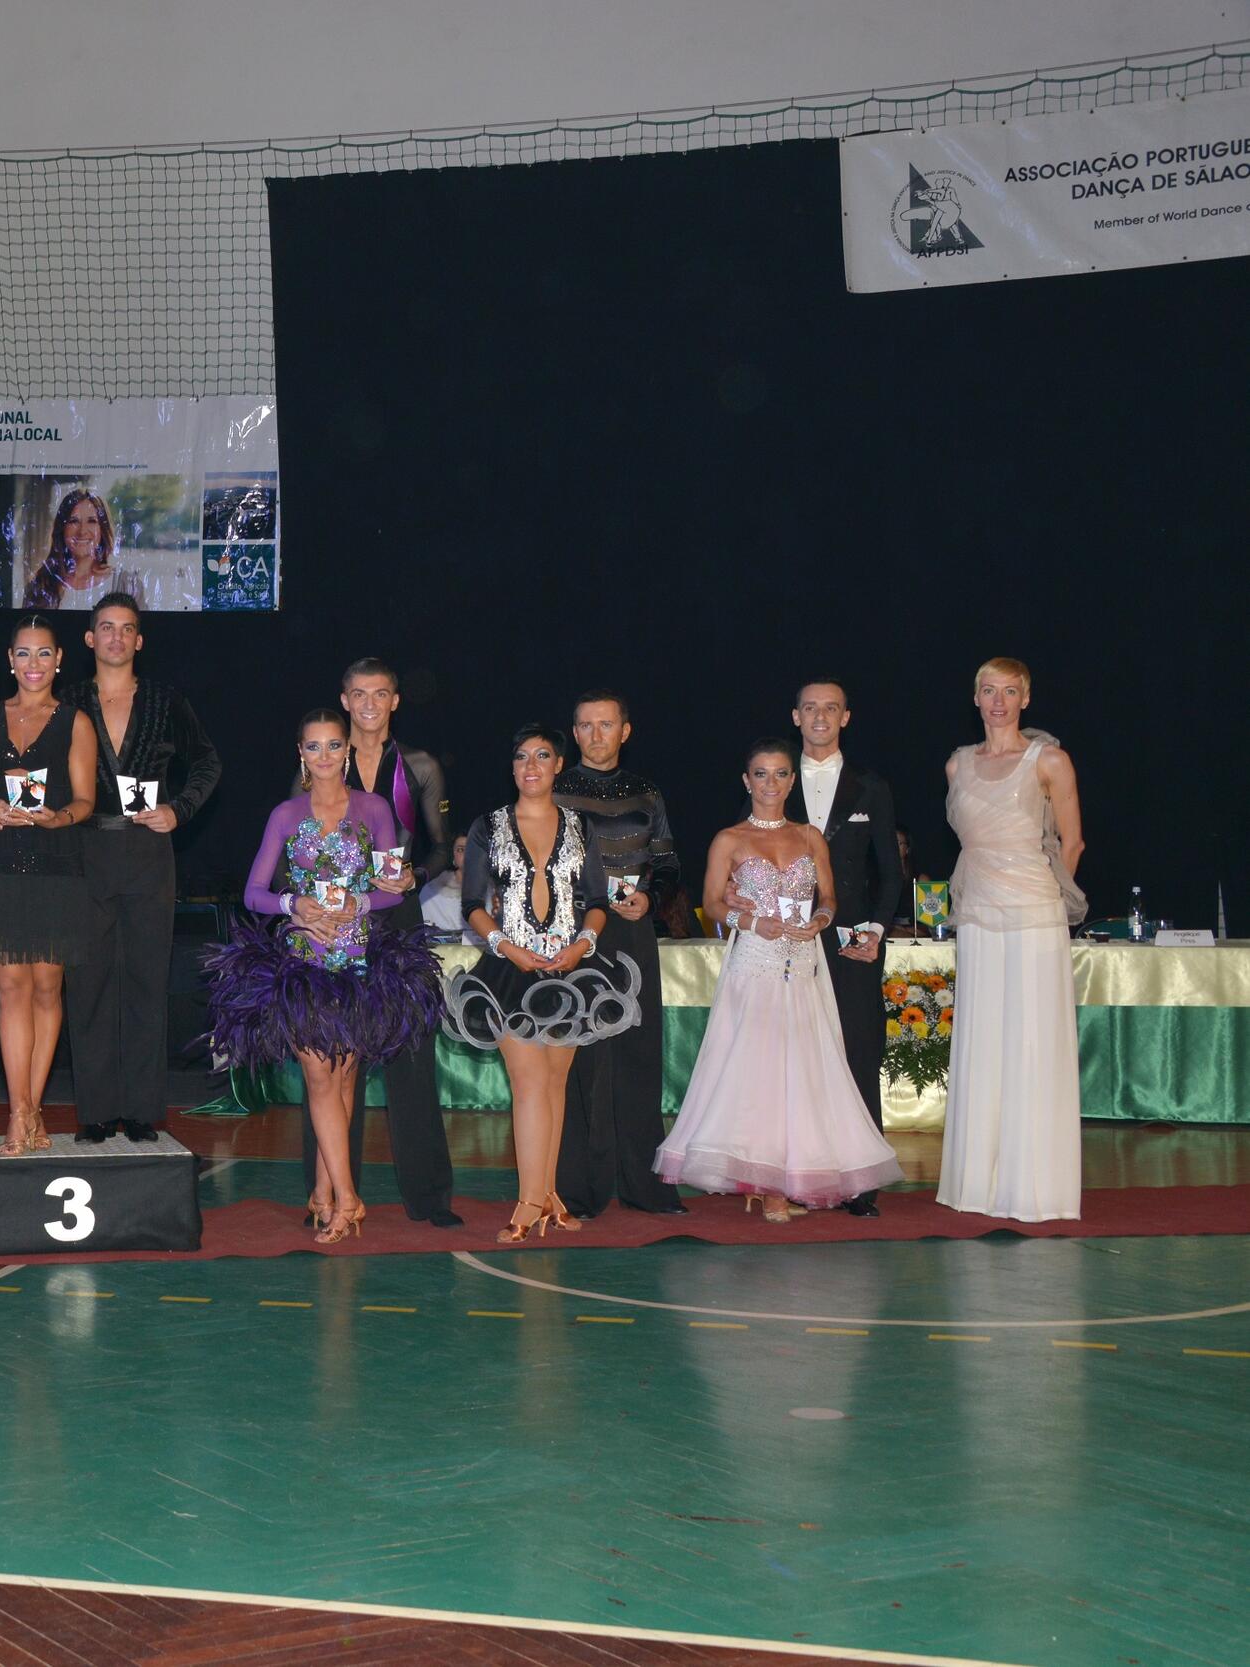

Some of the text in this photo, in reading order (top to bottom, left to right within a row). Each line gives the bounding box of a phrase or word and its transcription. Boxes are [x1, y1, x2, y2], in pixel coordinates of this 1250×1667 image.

[1004, 152, 1139, 183] ASSOCIAÇÃO
[1071, 177, 1145, 200] DANÇA
[1152, 172, 1178, 191] DE
[1093, 217, 1145, 230] Member
[1147, 214, 1161, 224] of
[1163, 209, 1197, 222] World
[1201, 204, 1242, 218] Dance
[15, 428, 62, 442] LOCAL
[237, 556, 269, 578] CA
[43, 1177, 96, 1242] 3
